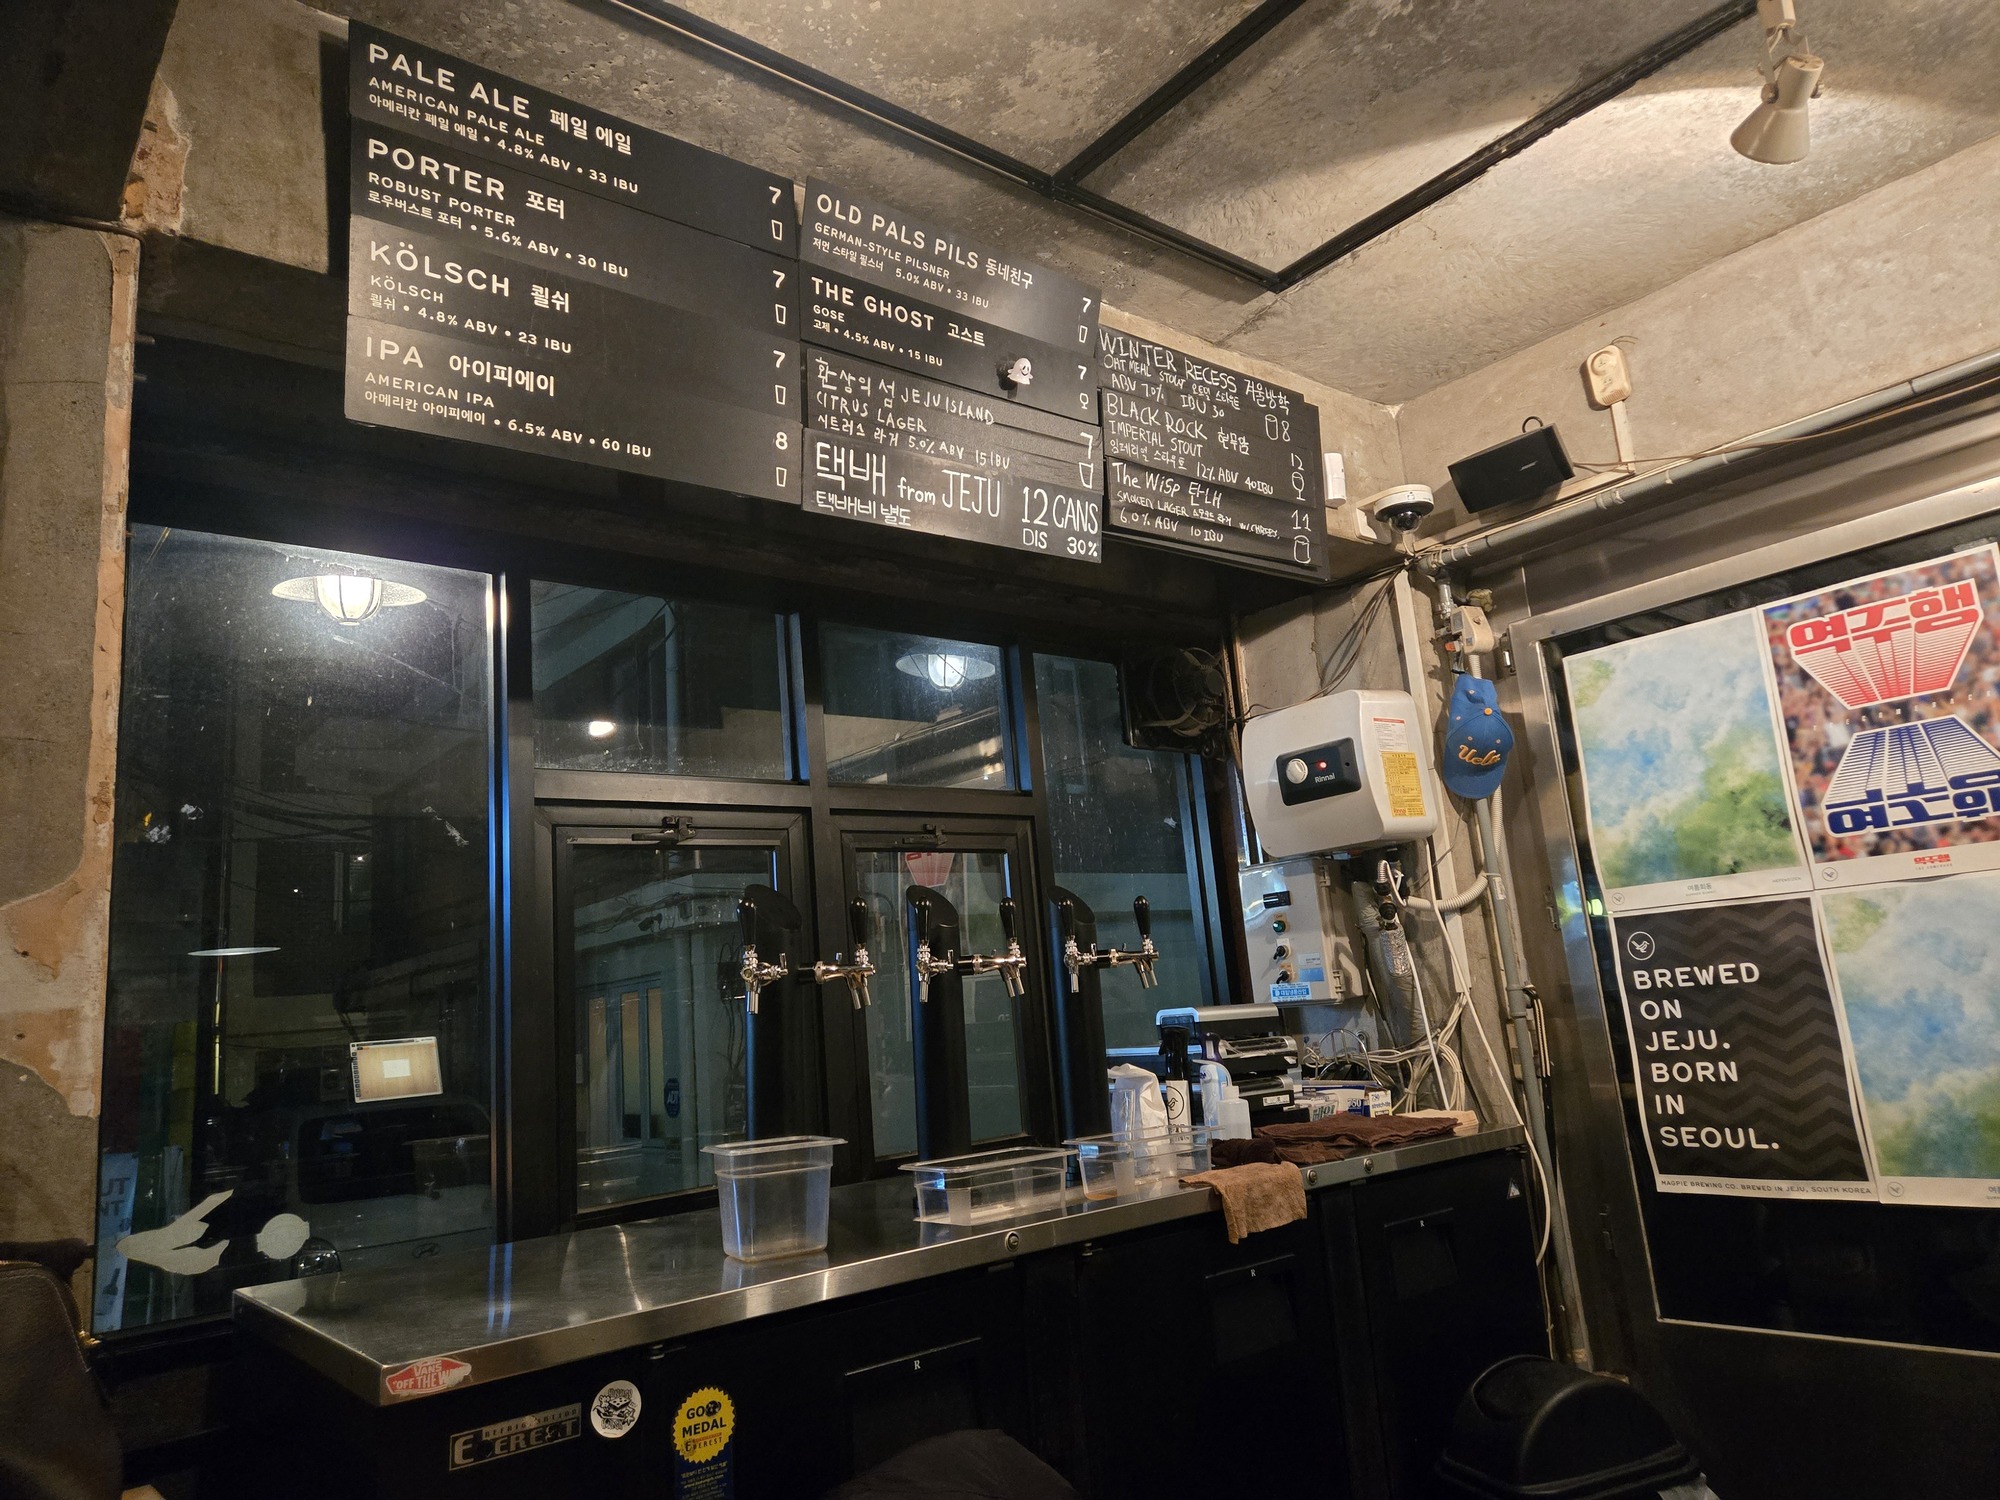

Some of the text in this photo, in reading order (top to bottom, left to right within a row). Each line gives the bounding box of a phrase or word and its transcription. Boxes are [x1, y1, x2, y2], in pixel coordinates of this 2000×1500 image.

[369, 43, 632, 155] PALE ALE 페일 에일
[369, 76, 545, 146] AMERICAN PALE ALE
[369, 94, 639, 194] 아메리칸 페일 에일 4.8% ABV 33 IBU
[368, 138, 566, 219] PORTER 포터
[368, 171, 516, 227] ROBUST PORTER
[768, 186, 782, 205] 7
[368, 189, 629, 278] 로우버스트 포터 5.6% ABV 30 IBU
[816, 193, 1033, 290] OLD PALS PILS 동네친구
[814, 222, 950, 279] GERMAN-STYLE PILSNER
[370, 241, 570, 313] KÖLSCH 쾰쉬
[370, 274, 444, 304] KÖLSCH
[773, 270, 787, 288] 7
[812, 237, 989, 309] 저먼 스타일 필스너 5.0% ABV 33 IBU
[811, 276, 985, 347] THE GHOST 고스트
[812, 304, 845, 322] GOSE
[1082, 297, 1092, 313] 7
[370, 292, 572, 354] 쾰쉬 4.8% ABV 23 IBU
[813, 319, 943, 366] 고제 4.5% ABV 15 IBU
[365, 336, 556, 397] IPA 아이피에이
[772, 350, 787, 369] 7
[1077, 365, 1087, 380] 7
[1099, 328, 1177, 372] WINTER
[1185, 356, 1237, 394] RECESS
[365, 371, 495, 408] AMERICAN IPA
[815, 357, 995, 426] 환상의 섬 JEJU ISLAND
[1112, 373, 1136, 391] ABV
[1181, 394, 1207, 414] IBU
[1212, 406, 1225, 417] 30
[1159, 371, 1187, 390] STOUT
[365, 390, 652, 458] 아메리칸 아이피에이 6.5% ABV 60 IBU
[816, 391, 927, 433] CITRUS LAGER
[1106, 393, 1161, 426] BLACK
[1165, 412, 1208, 440] ROCK
[775, 431, 788, 450] 8
[817, 413, 866, 437] 시트러스
[873, 425, 898, 447] 라거
[908, 435, 935, 454] 5.0%
[939, 441, 964, 460] ABV
[1080, 432, 1094, 460] 7
[1108, 420, 1203, 457] IMPERIAL STOUT
[1112, 462, 1141, 489] The
[1218, 466, 1239, 484] ABV
[1291, 453, 1304, 471] 12
[816, 441, 1098, 535] 택배 from JEJU 12 CANS
[816, 490, 911, 527] 택배비 별도
[1291, 508, 1313, 532] 11
[1022, 528, 1098, 557] DIS 30%
[1155, 517, 1180, 533] ABV
[1190, 525, 1201, 538] 10
[1204, 529, 1224, 544] IBU
[1633, 962, 1760, 990] BREWED
[1640, 999, 1682, 1021] ON
[1645, 1029, 1731, 1052] JEJU.
[1651, 1061, 1738, 1083] BORN
[1655, 1094, 1685, 1116] IN
[1659, 1127, 1780, 1150] SEOUL.
[1690, 1181, 1723, 1189] BREWING
[1741, 1184, 1772, 1192] BREWED
[1785, 1185, 1809, 1193] JEJU,
[416, 1373, 438, 1389] THE
[682, 1417, 727, 1438] MEDAL
